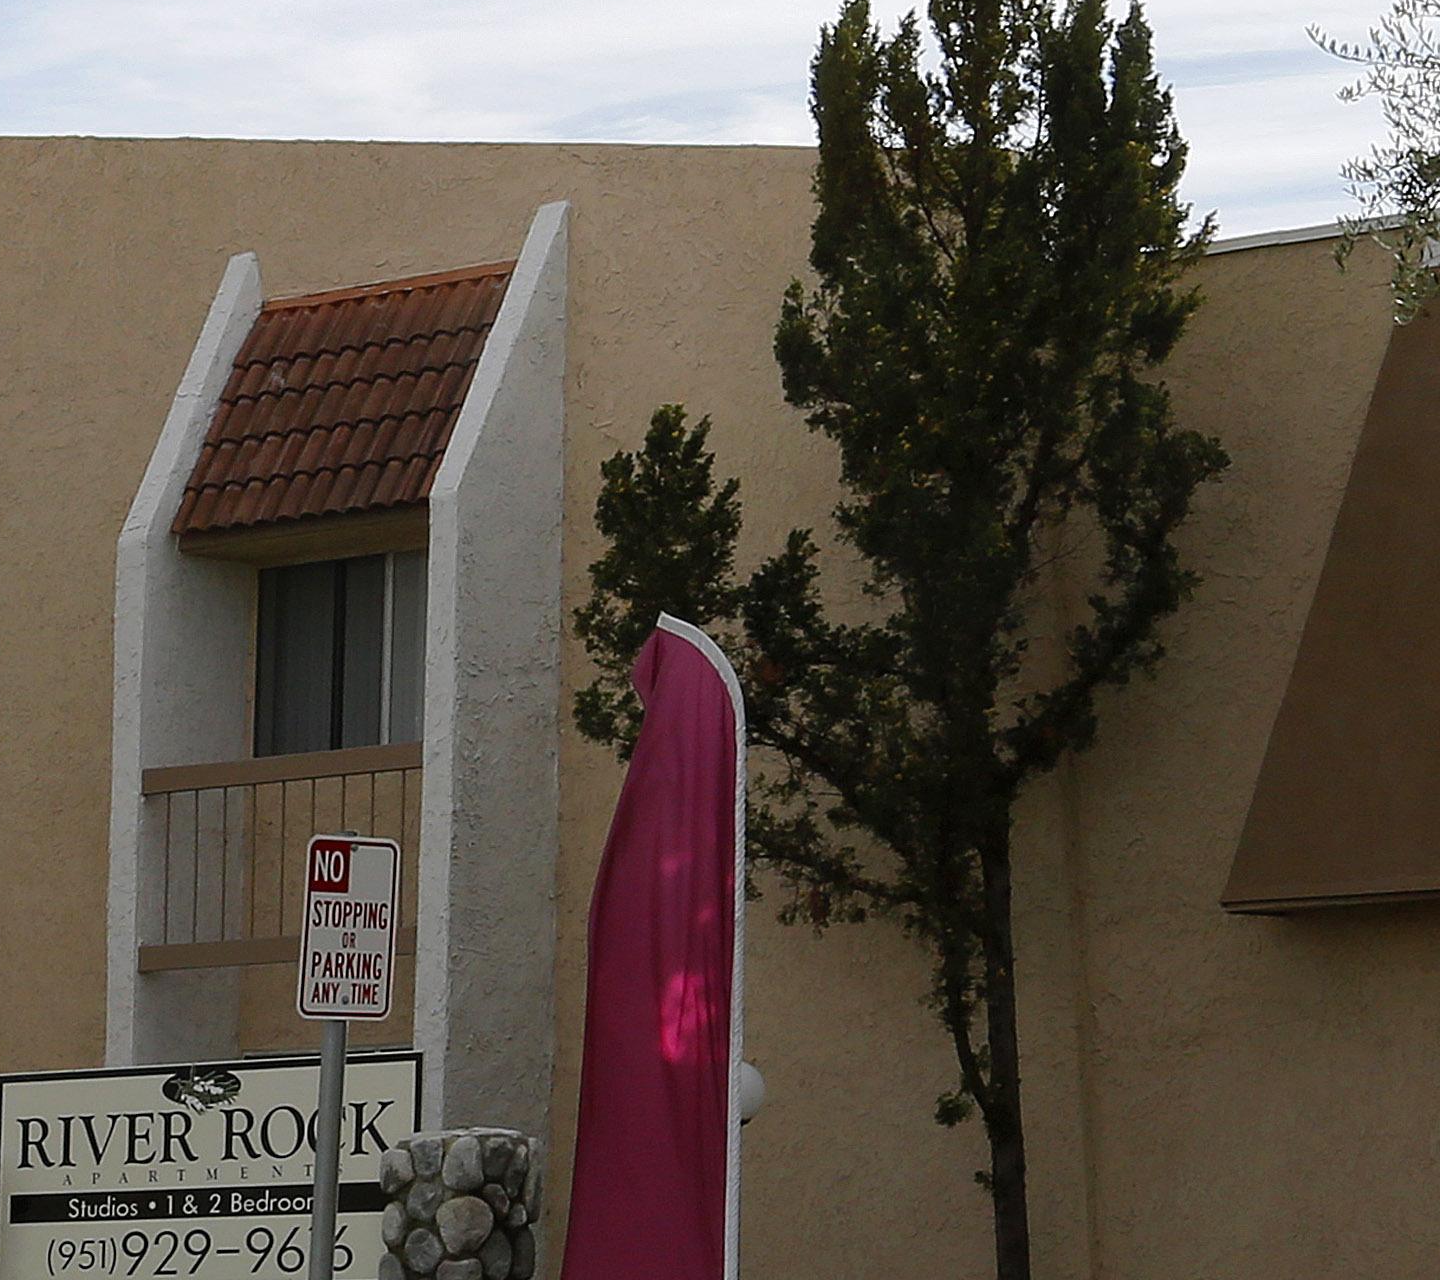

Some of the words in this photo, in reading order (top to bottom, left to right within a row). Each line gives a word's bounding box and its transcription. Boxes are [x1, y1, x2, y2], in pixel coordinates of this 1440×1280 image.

[313, 849, 345, 883] NO
[311, 900, 389, 930] STOPPING
[341, 932, 357, 949] OR
[310, 951, 384, 981] PARKING
[310, 982, 341, 1005] ANY
[350, 983, 380, 1006] TIME
[16, 1110, 200, 1169] RIVER
[62, 1164, 343, 1186] APARTMENT
[68, 1195, 139, 1218] Studios
[166, 1195, 173, 1215] 1
[182, 1194, 199, 1214] &
[208, 1193, 221, 1214] 2
[47, 1225, 353, 1277] (951)929-966
